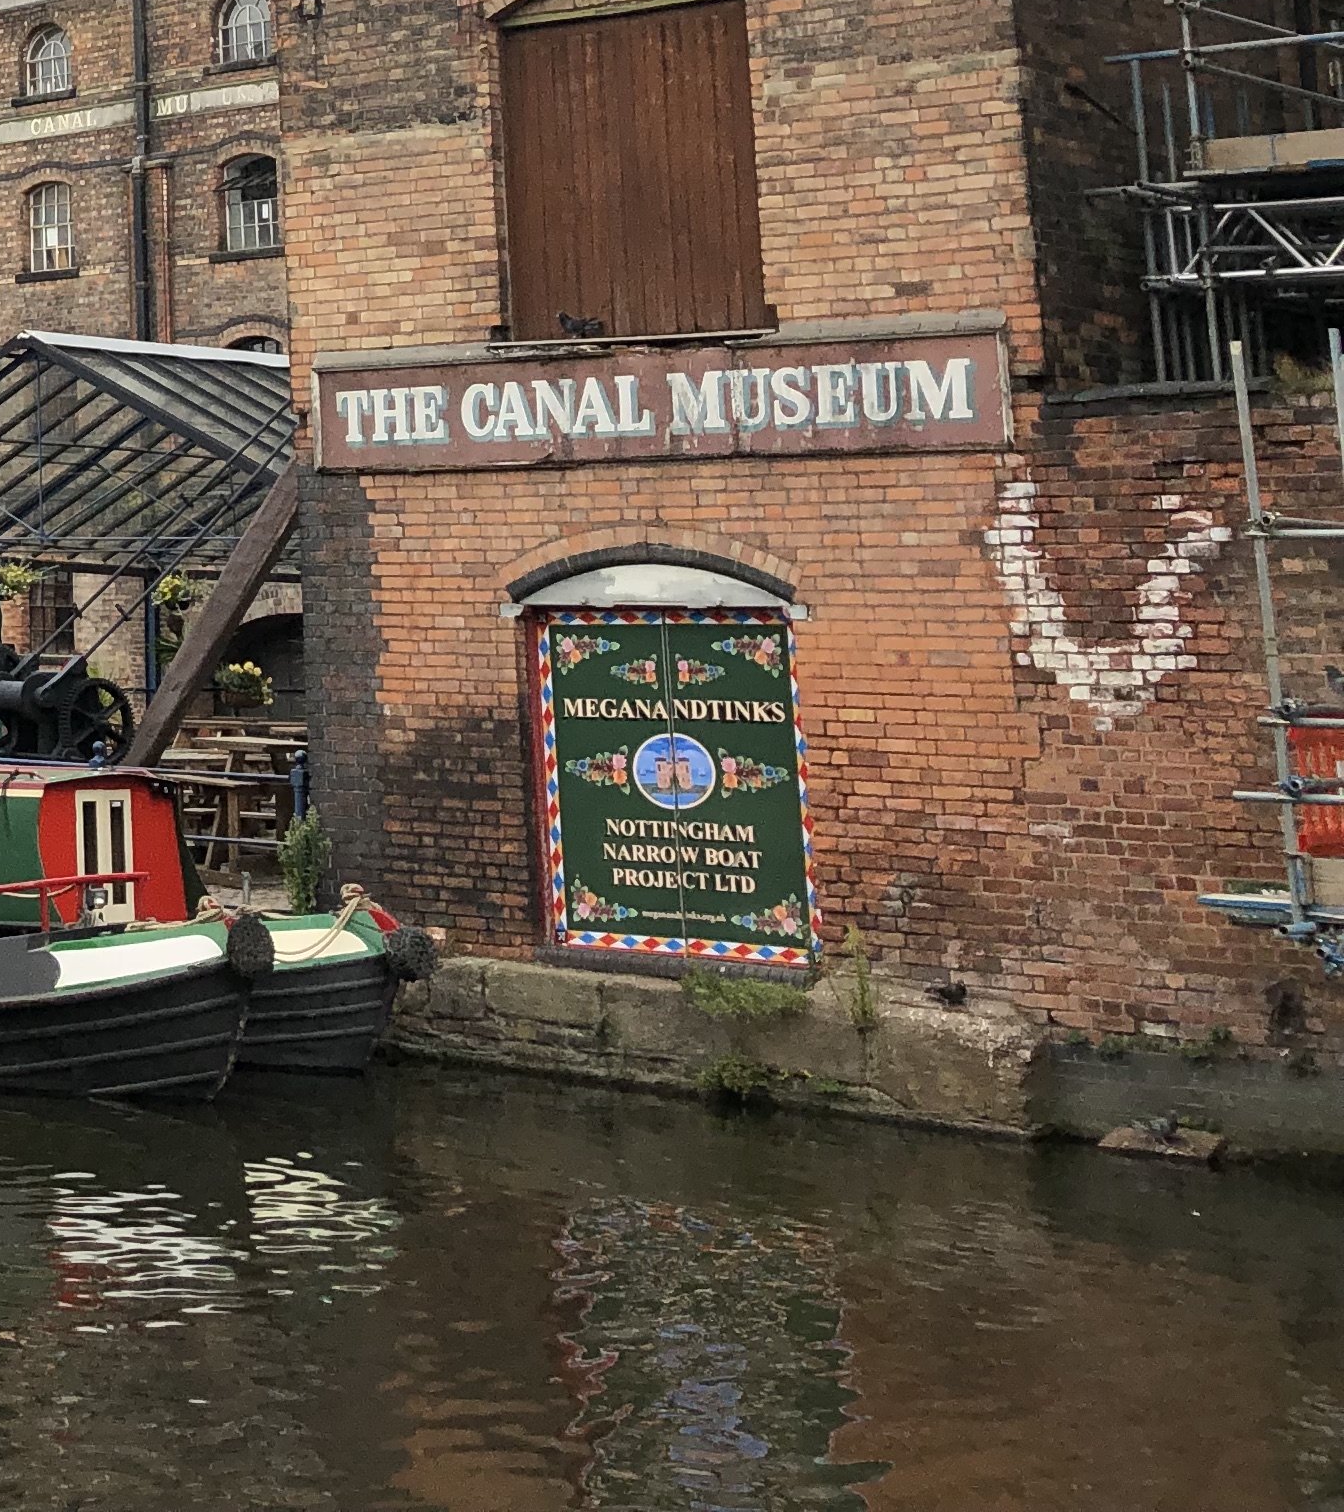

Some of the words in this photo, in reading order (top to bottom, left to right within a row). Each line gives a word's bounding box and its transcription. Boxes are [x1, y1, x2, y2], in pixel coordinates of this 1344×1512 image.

[30, 110, 97, 136] CANAL
[335, 385, 449, 444] THE
[460, 374, 656, 437] CANAL
[666, 357, 977, 435] MUSEUM
[562, 697, 786, 723] MEGANANDTINKS
[605, 818, 755, 843] NOTTINGHAM
[603, 842, 700, 864] NARROW
[705, 847, 762, 869] BOAT
[612, 867, 710, 890] PROJECT
[715, 873, 756, 894] LTD
